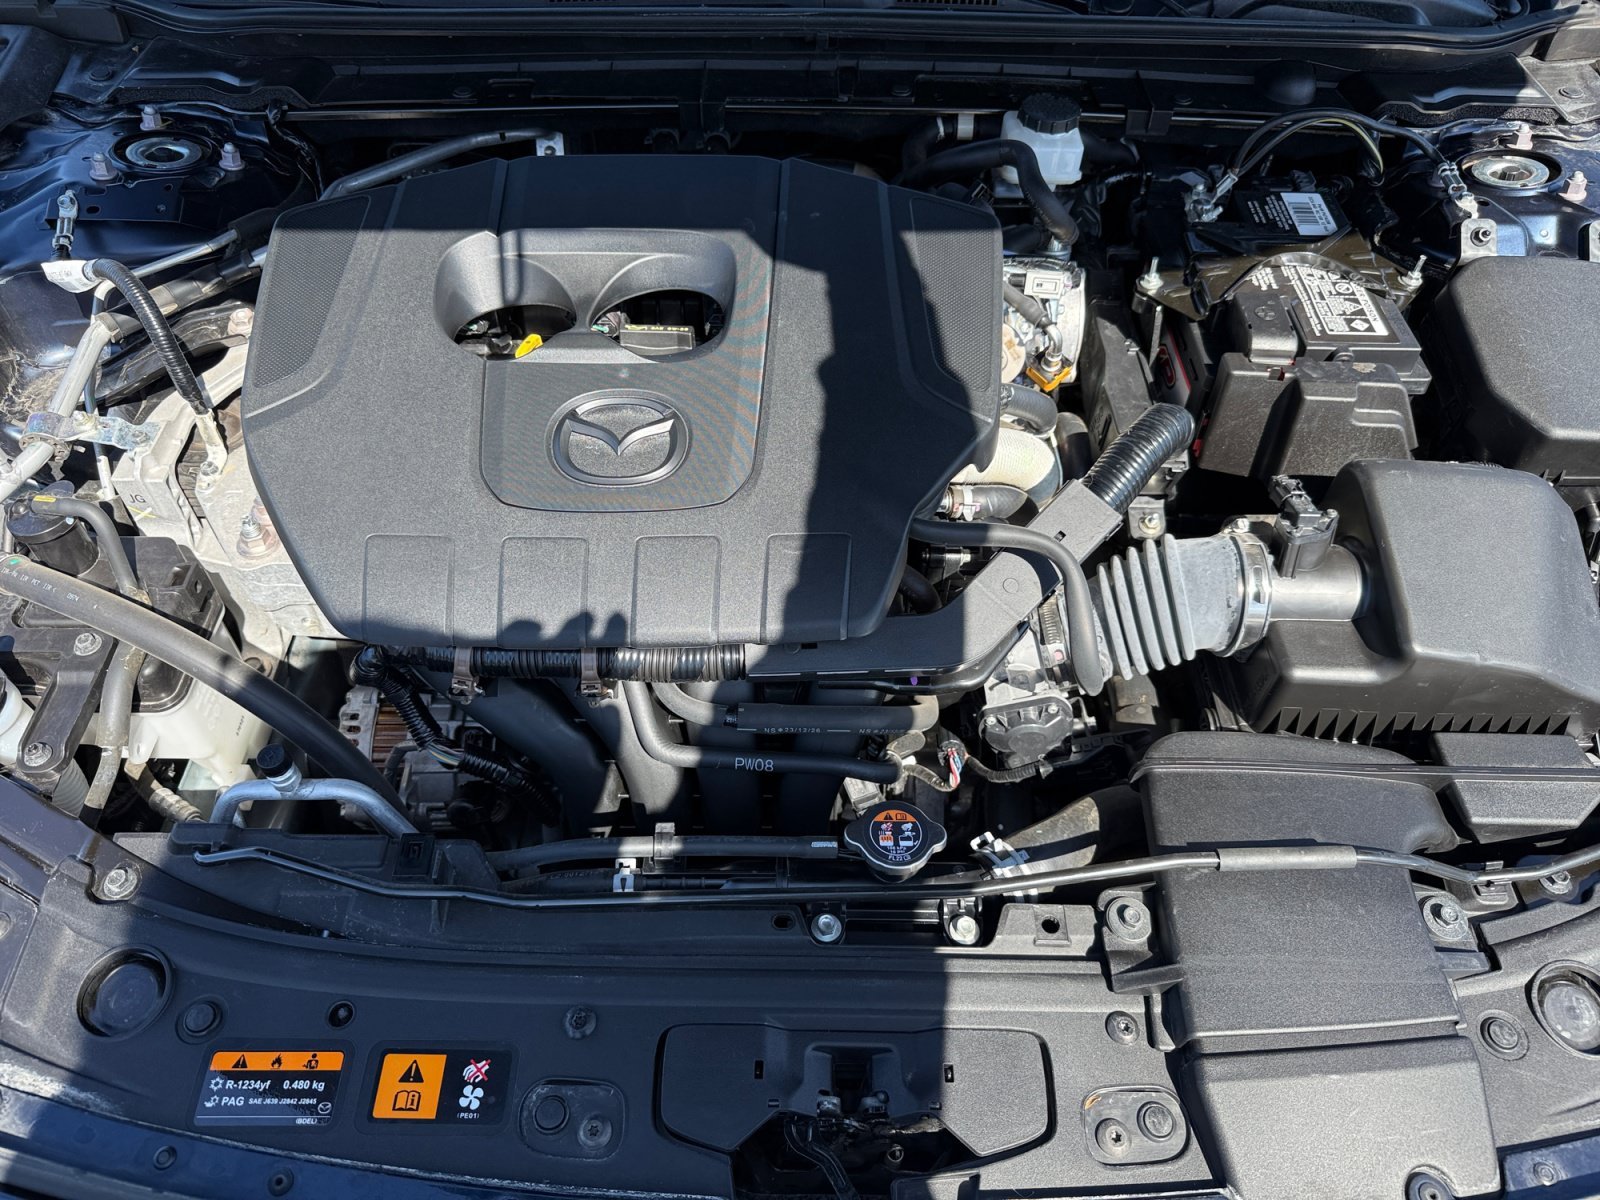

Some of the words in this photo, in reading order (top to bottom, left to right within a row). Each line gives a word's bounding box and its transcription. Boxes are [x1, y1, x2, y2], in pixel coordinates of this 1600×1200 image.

[1362, 299, 1378, 321] POISON
[734, 757, 774, 772] PW08
[226, 1080, 271, 1091] R-1234yf
[283, 1080, 310, 1090] 0.480
[312, 1080, 326, 1092] kg
[221, 1096, 245, 1106] PAG
